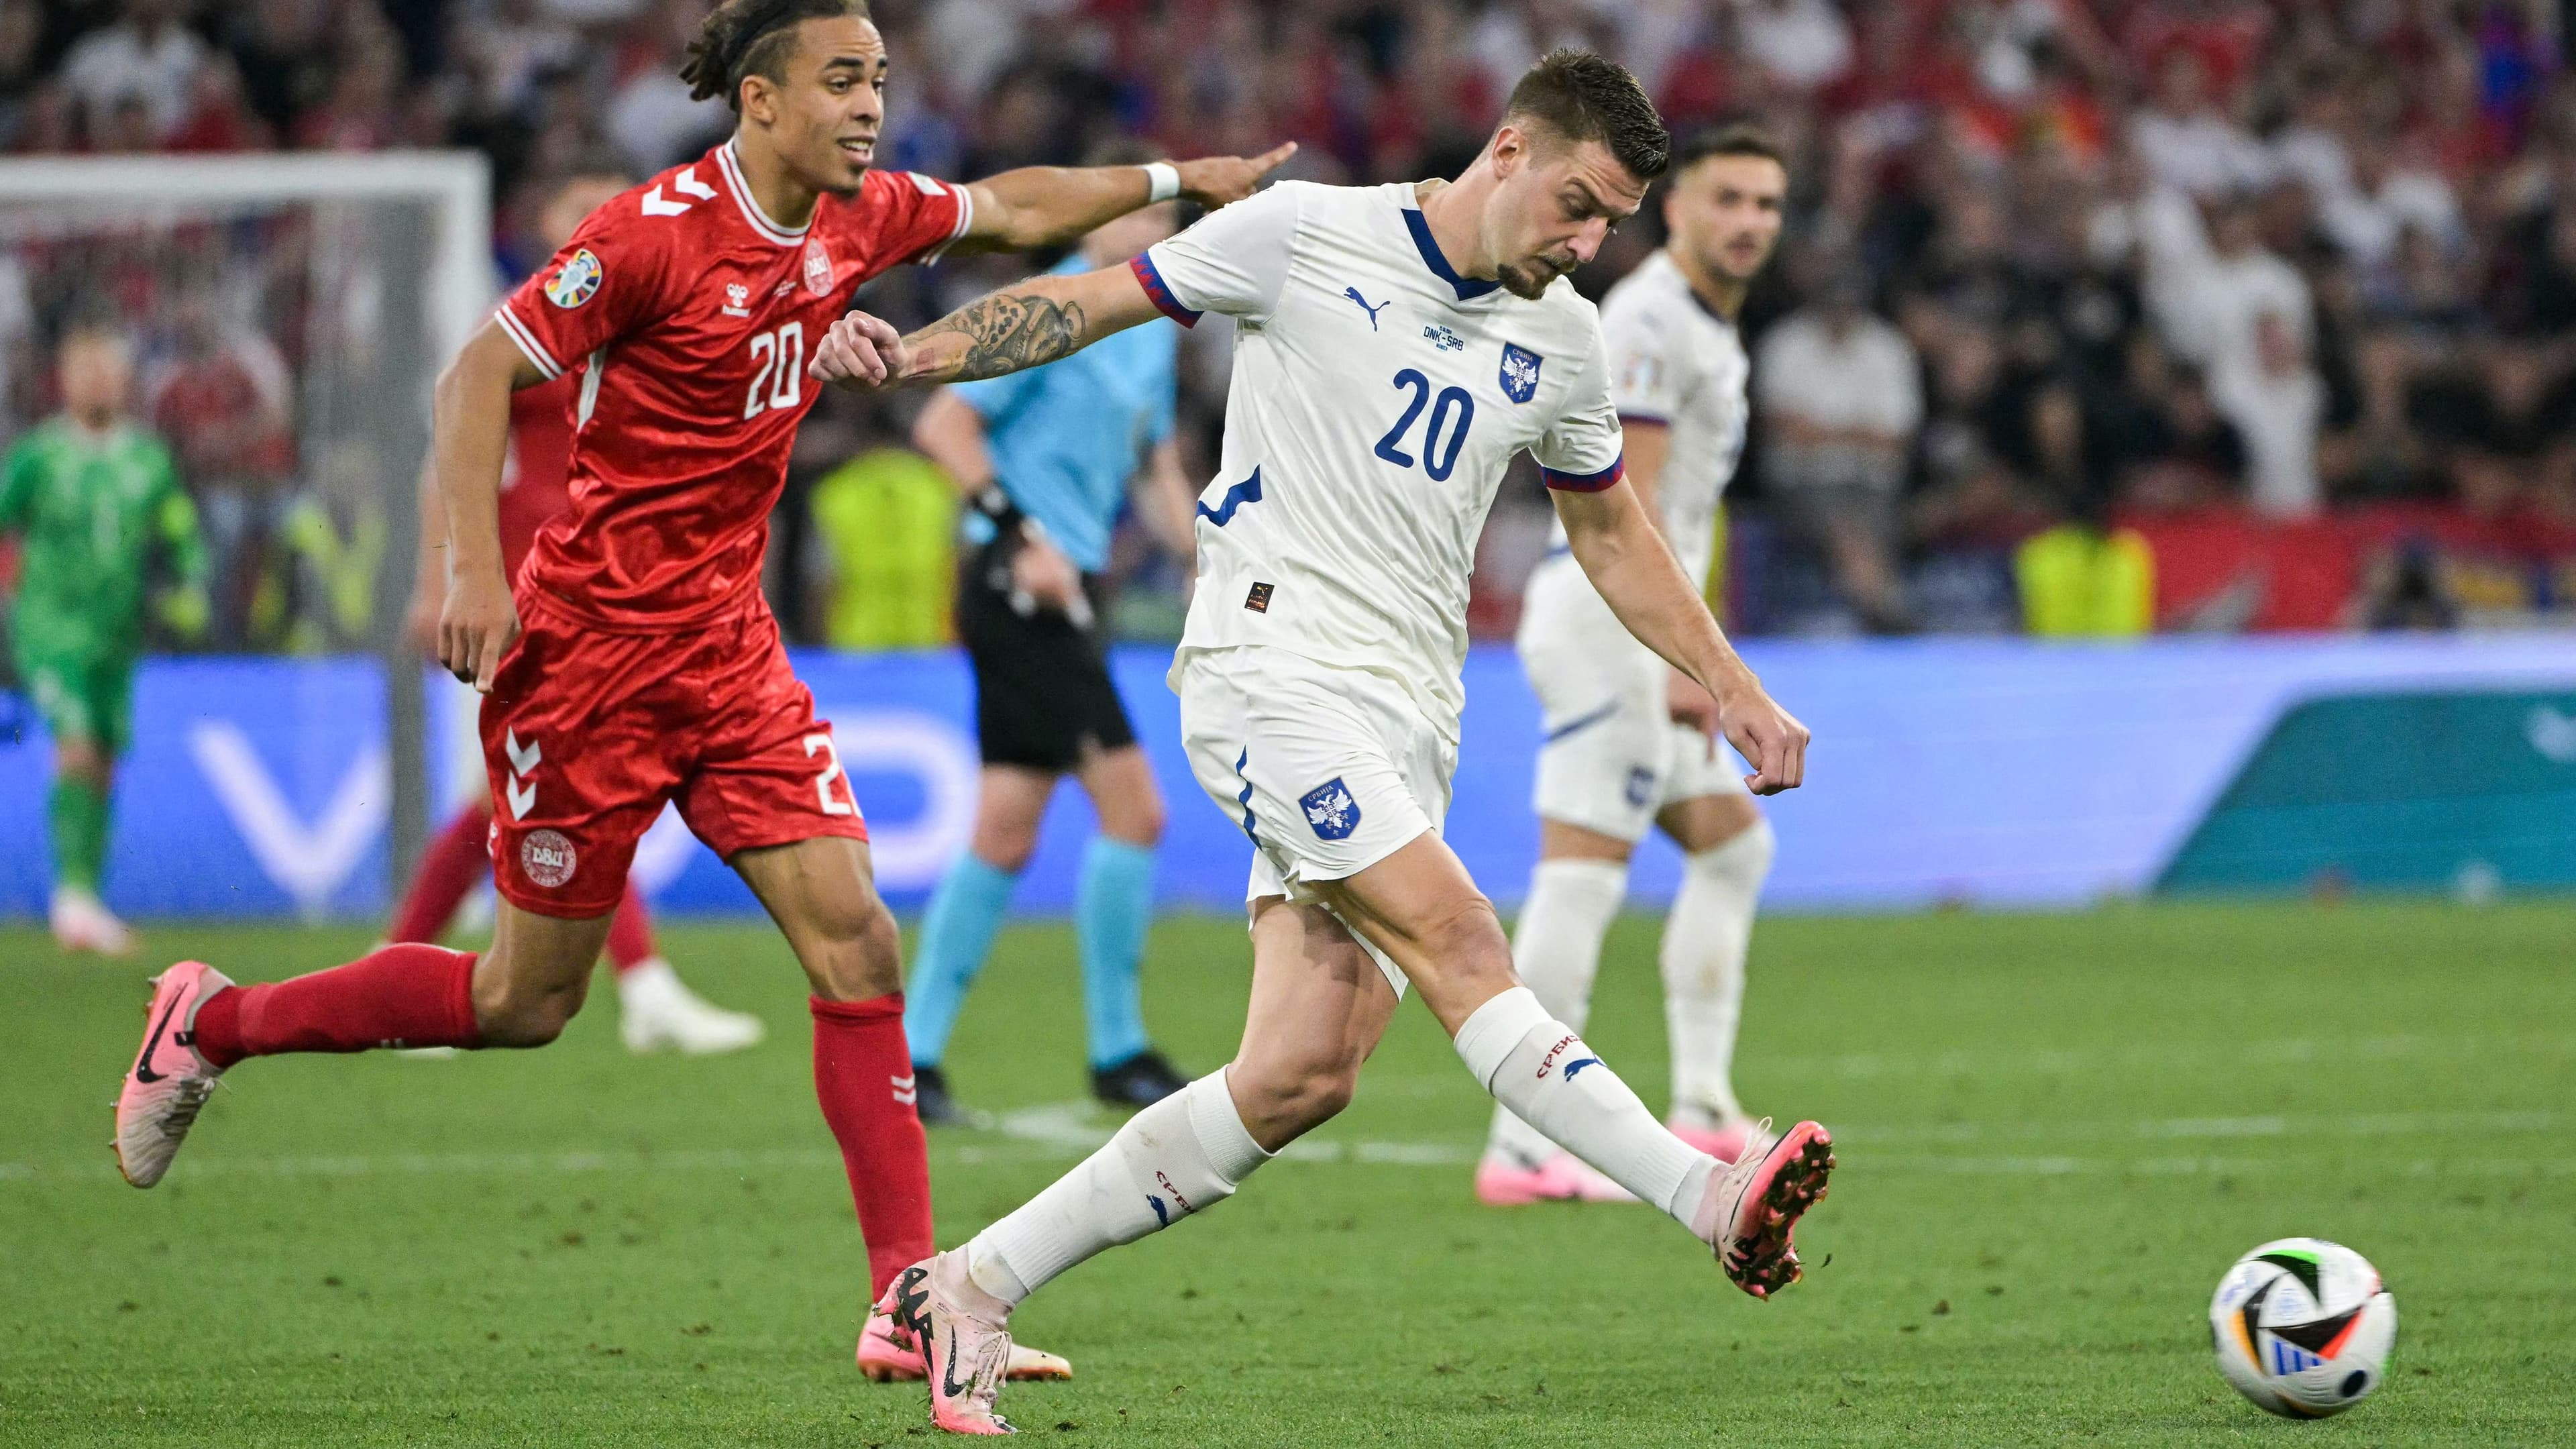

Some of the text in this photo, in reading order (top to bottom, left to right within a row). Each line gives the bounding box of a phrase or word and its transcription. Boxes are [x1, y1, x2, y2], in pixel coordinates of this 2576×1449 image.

[744, 320, 804, 421] 20
[1374, 368, 1474, 482] 20
[532, 846, 564, 867] DBU
